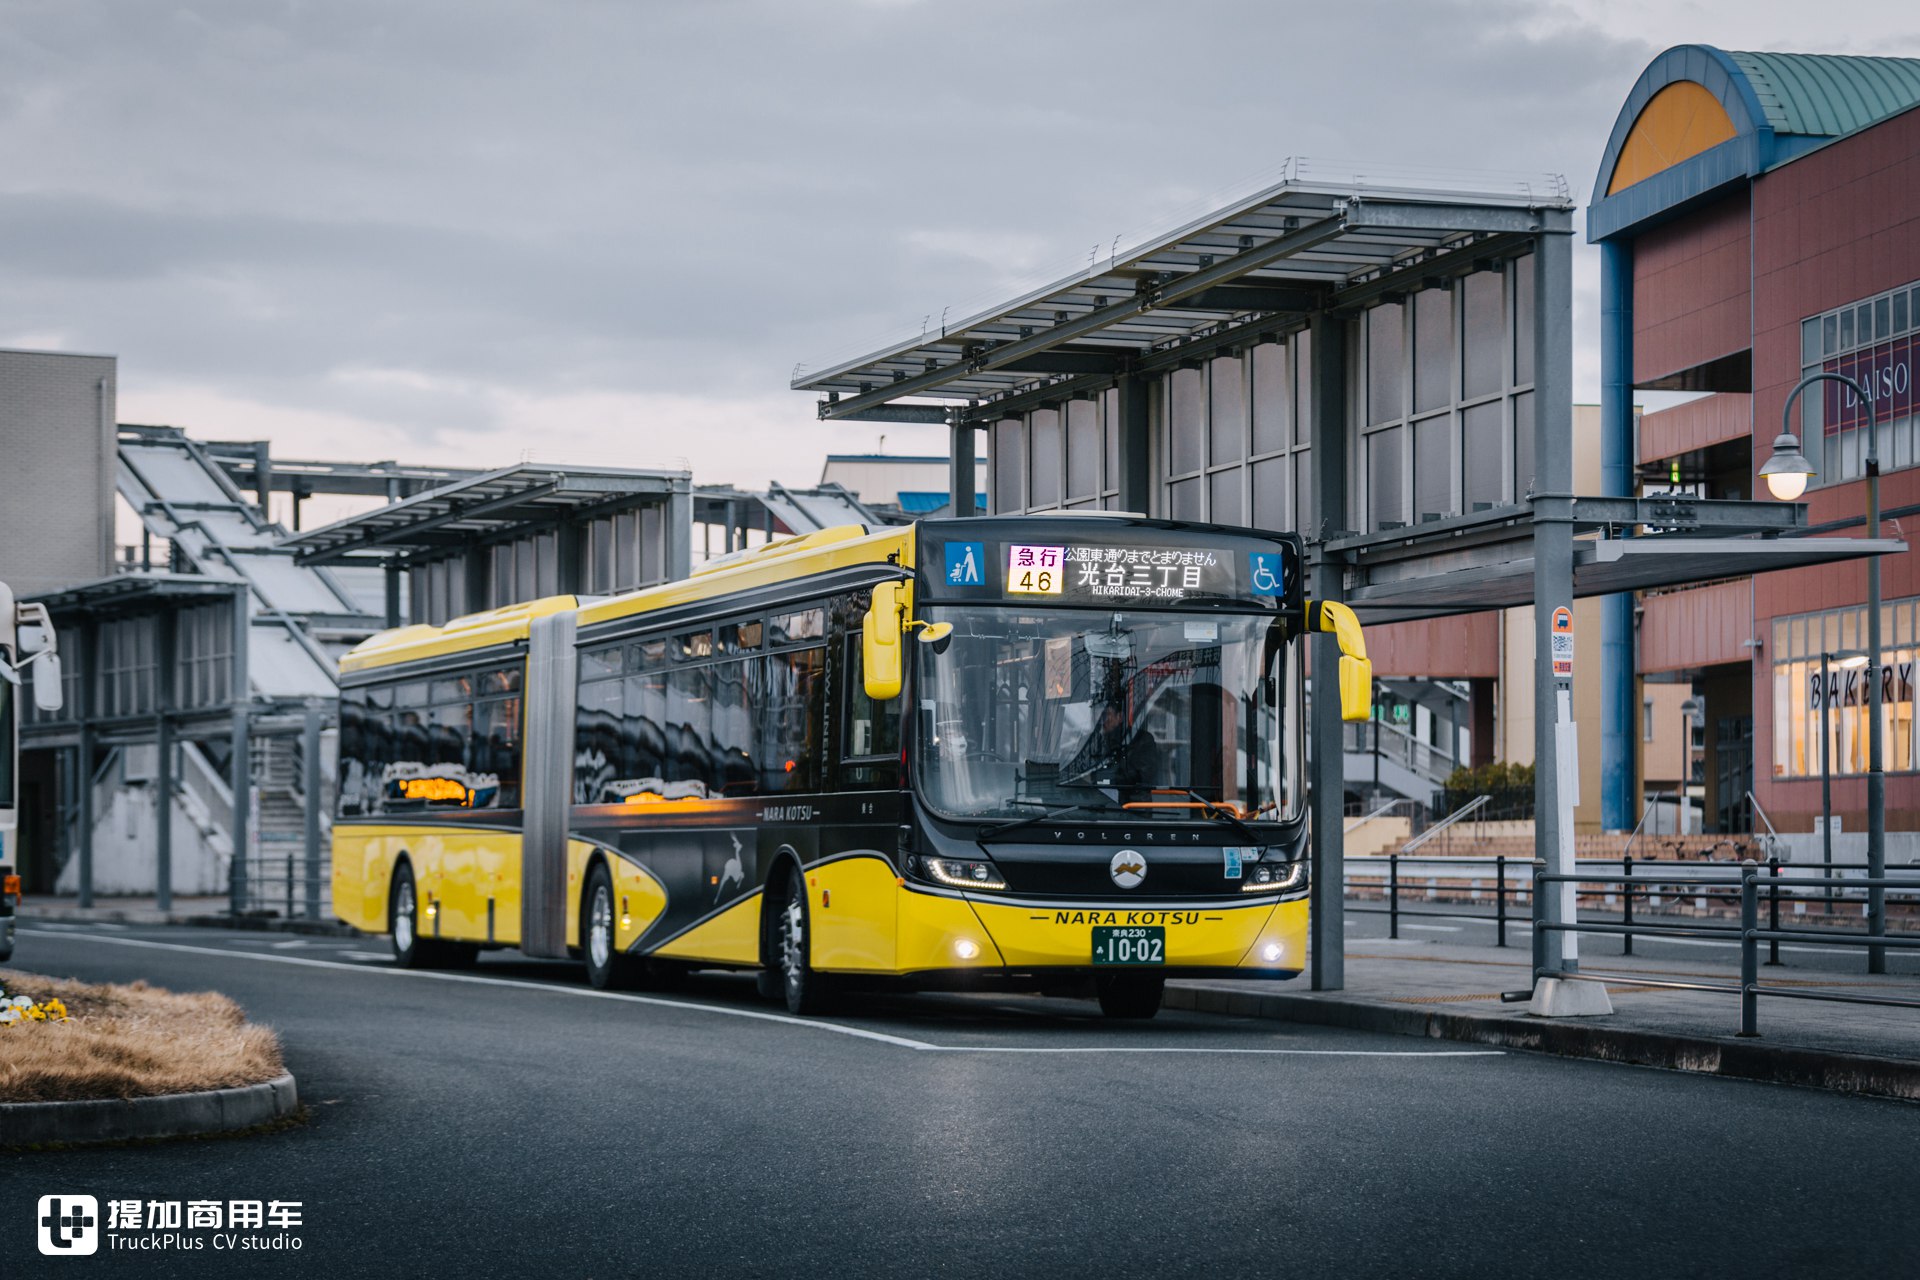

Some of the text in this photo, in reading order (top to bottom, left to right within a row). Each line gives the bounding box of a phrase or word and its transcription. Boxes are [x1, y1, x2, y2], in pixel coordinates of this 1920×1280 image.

[1846, 362, 1908, 409] DAISO
[1018, 548, 1057, 567] 急行
[1064, 547, 1217, 566] 公園東通りまでとまりません
[1019, 571, 1052, 592] 46
[1078, 561, 1201, 588] 光台三丁目
[1810, 663, 1912, 710] BAKERY
[763, 805, 813, 821] NARA KOTSU
[1054, 831, 1200, 841] VOLGREN
[1055, 911, 1200, 925] NARA KOTSU
[1108, 938, 1163, 962] 10-02
